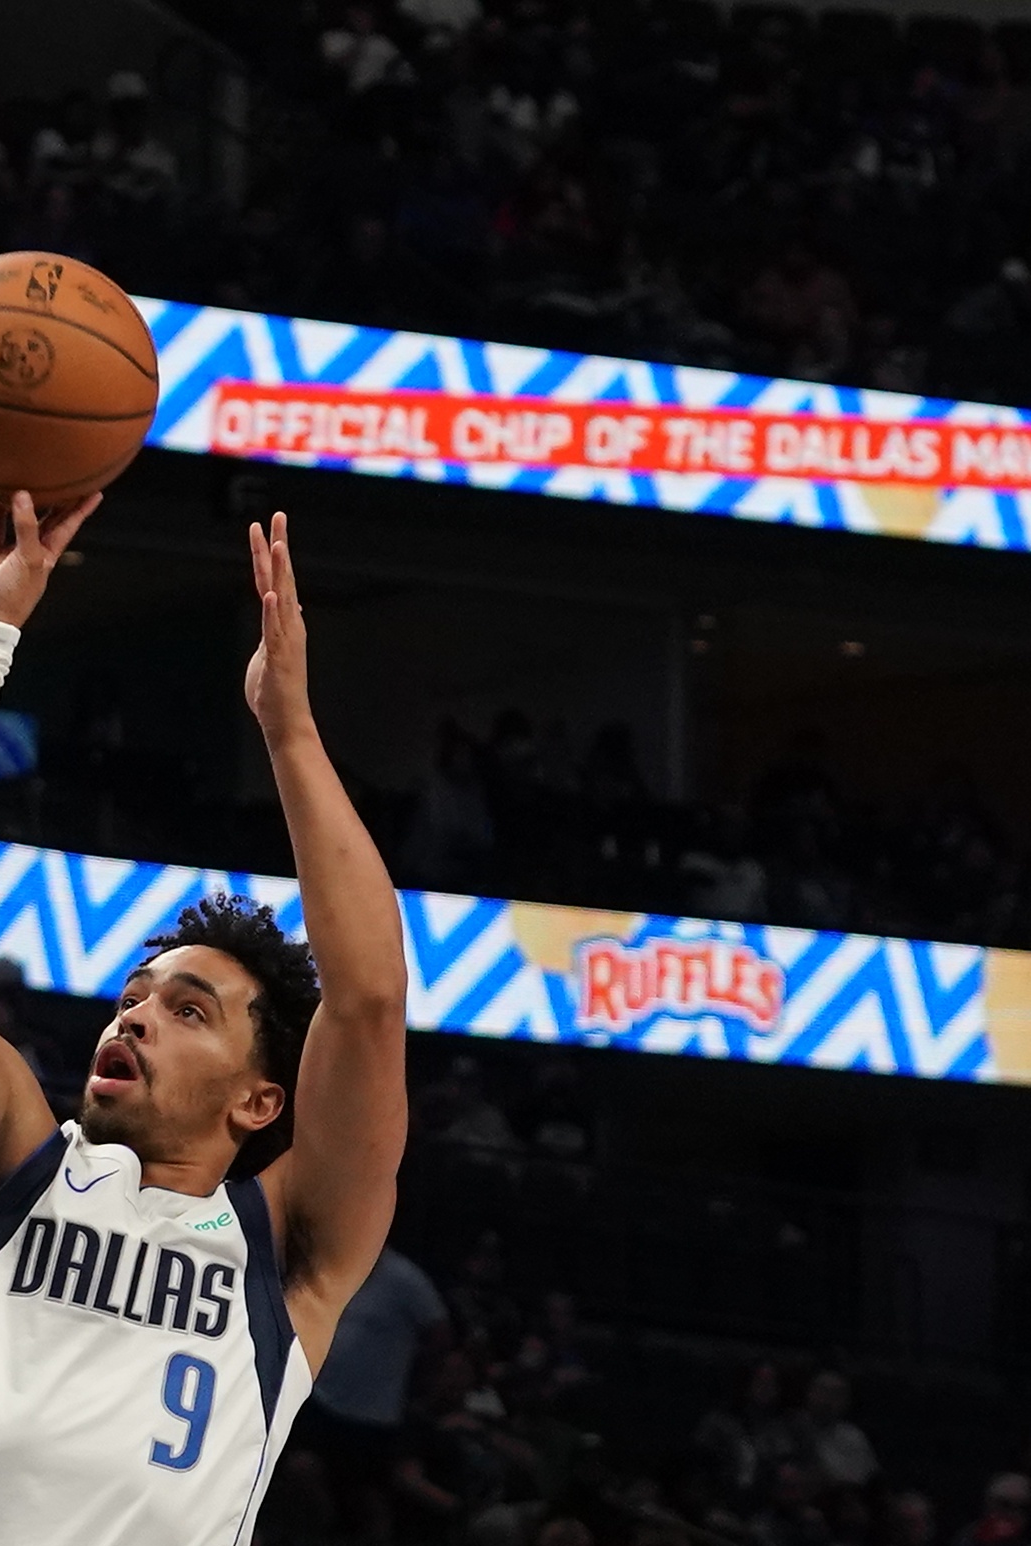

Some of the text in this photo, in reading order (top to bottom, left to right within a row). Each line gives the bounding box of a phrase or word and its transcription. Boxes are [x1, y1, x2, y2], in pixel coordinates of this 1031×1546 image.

[215, 399, 1031, 482] OFFICIAL CHIP OF THE DALLAS MA
[581, 942, 783, 1025] RUFFLES
[7, 1217, 238, 1341] DALLAS
[147, 1350, 218, 1473] 9
